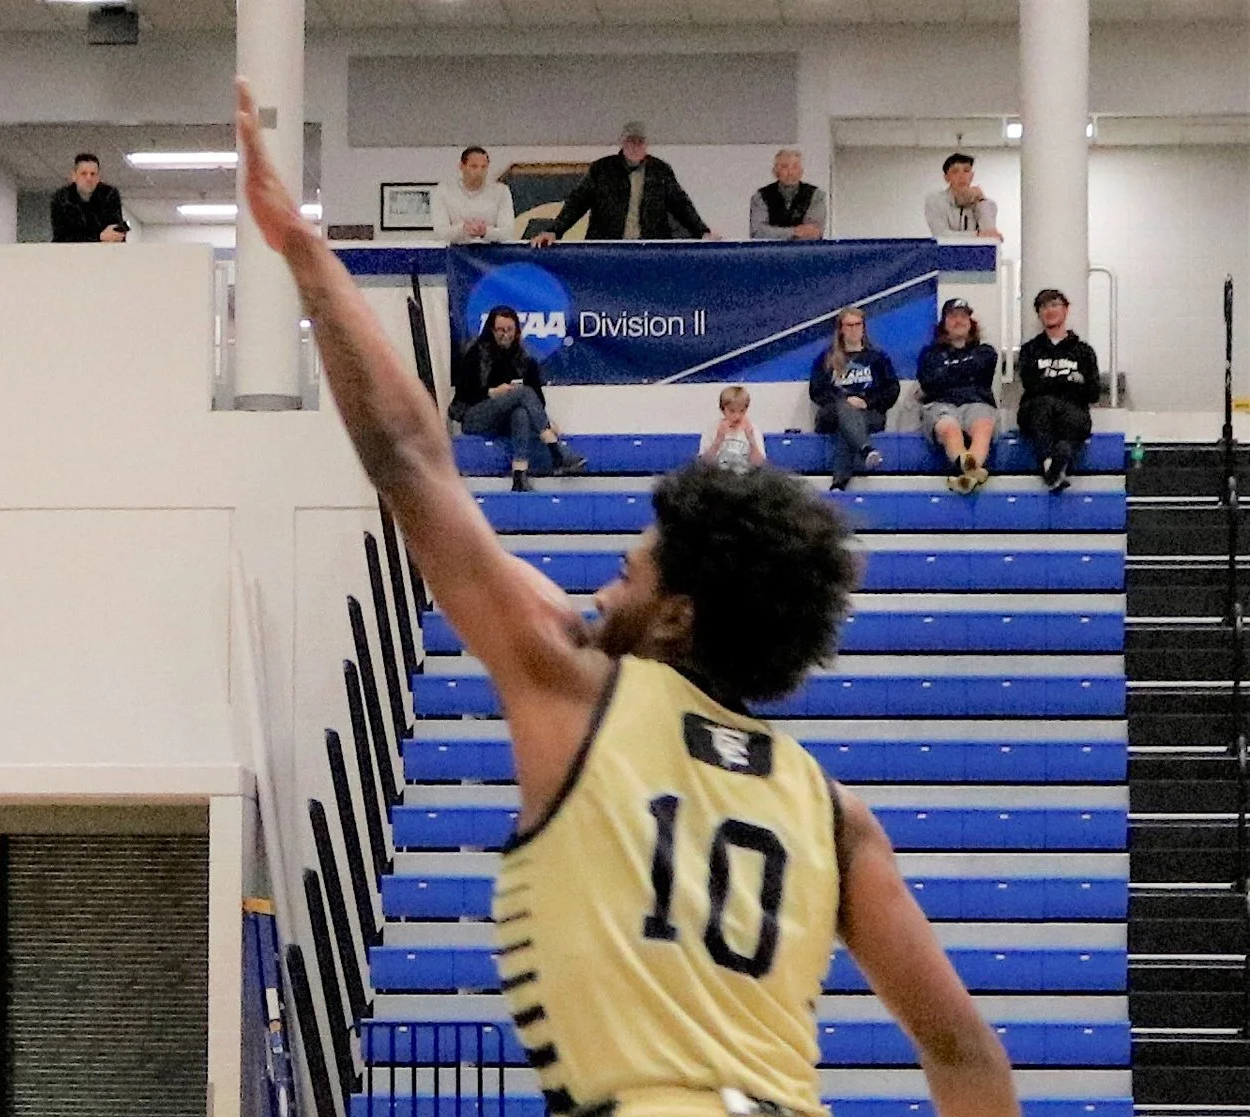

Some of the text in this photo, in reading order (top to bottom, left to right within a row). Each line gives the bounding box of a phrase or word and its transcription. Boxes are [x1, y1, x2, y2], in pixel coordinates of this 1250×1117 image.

[579, 311, 686, 338] Division
[694, 309, 706, 336] II
[642, 794, 787, 980] 10
